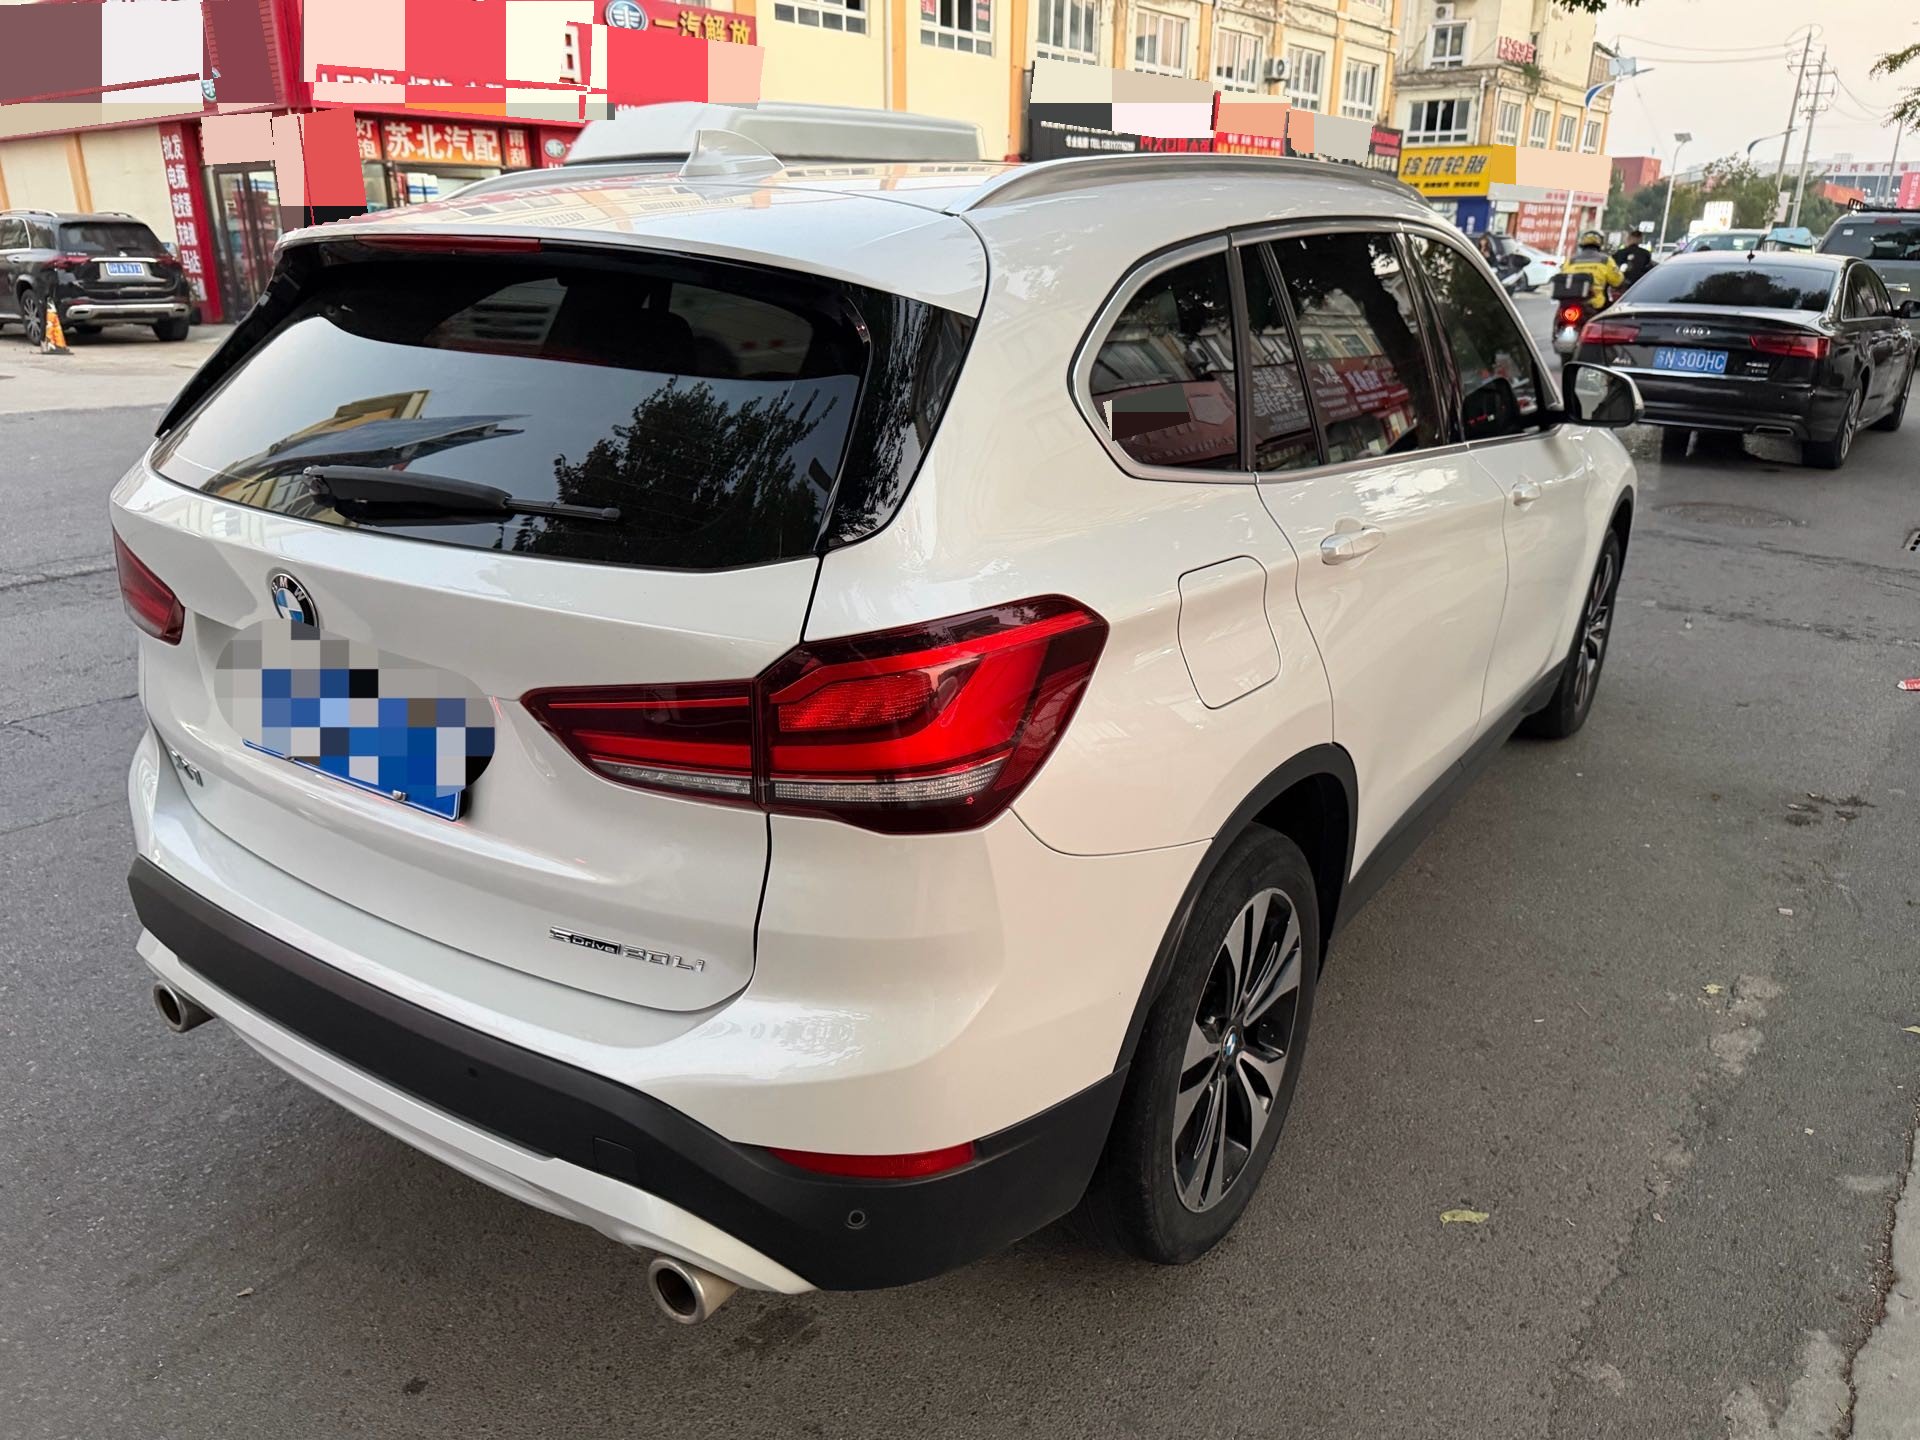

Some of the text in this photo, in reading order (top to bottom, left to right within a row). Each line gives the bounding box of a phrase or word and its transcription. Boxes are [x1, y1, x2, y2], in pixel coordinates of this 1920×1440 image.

[652, 10, 751, 45] 一汽解放
[384, 123, 500, 162] 苏北汽配
[272, 576, 306, 601] BMW
